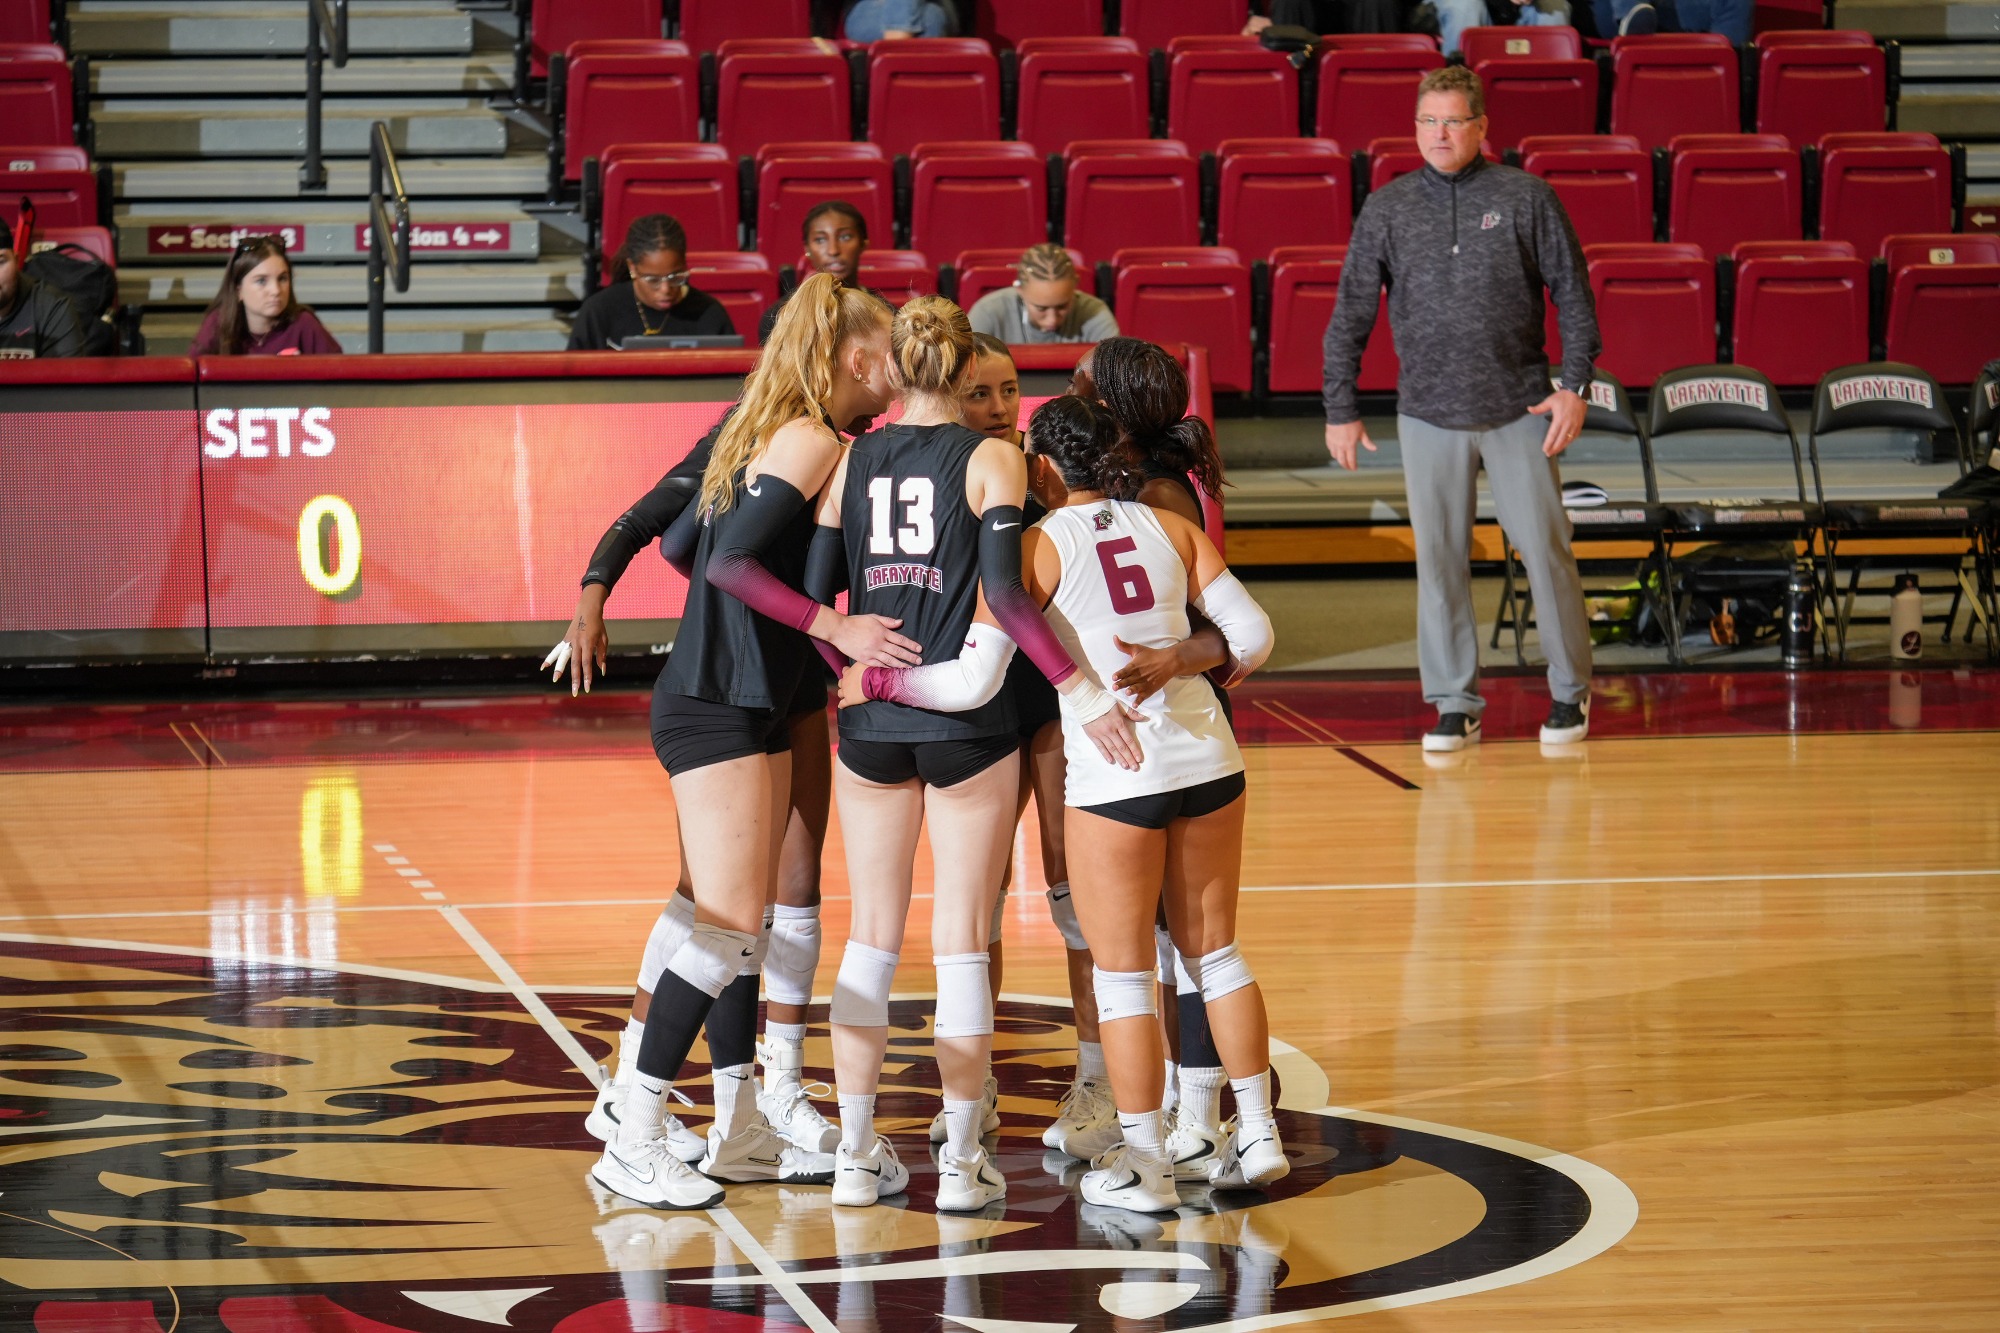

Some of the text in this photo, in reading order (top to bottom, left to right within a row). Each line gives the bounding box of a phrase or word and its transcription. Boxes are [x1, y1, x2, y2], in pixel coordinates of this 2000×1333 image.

[190, 228, 296, 248] Sect 3
[453, 226, 470, 246] 4
[1667, 380, 1766, 407] LAFAYETTE
[1833, 379, 1931, 406] LAFAYETTE
[204, 407, 336, 458] SETS
[868, 477, 935, 555] 13
[297, 494, 362, 596] 0
[866, 564, 941, 591] LAFAYETTE
[1095, 535, 1155, 615] 6
